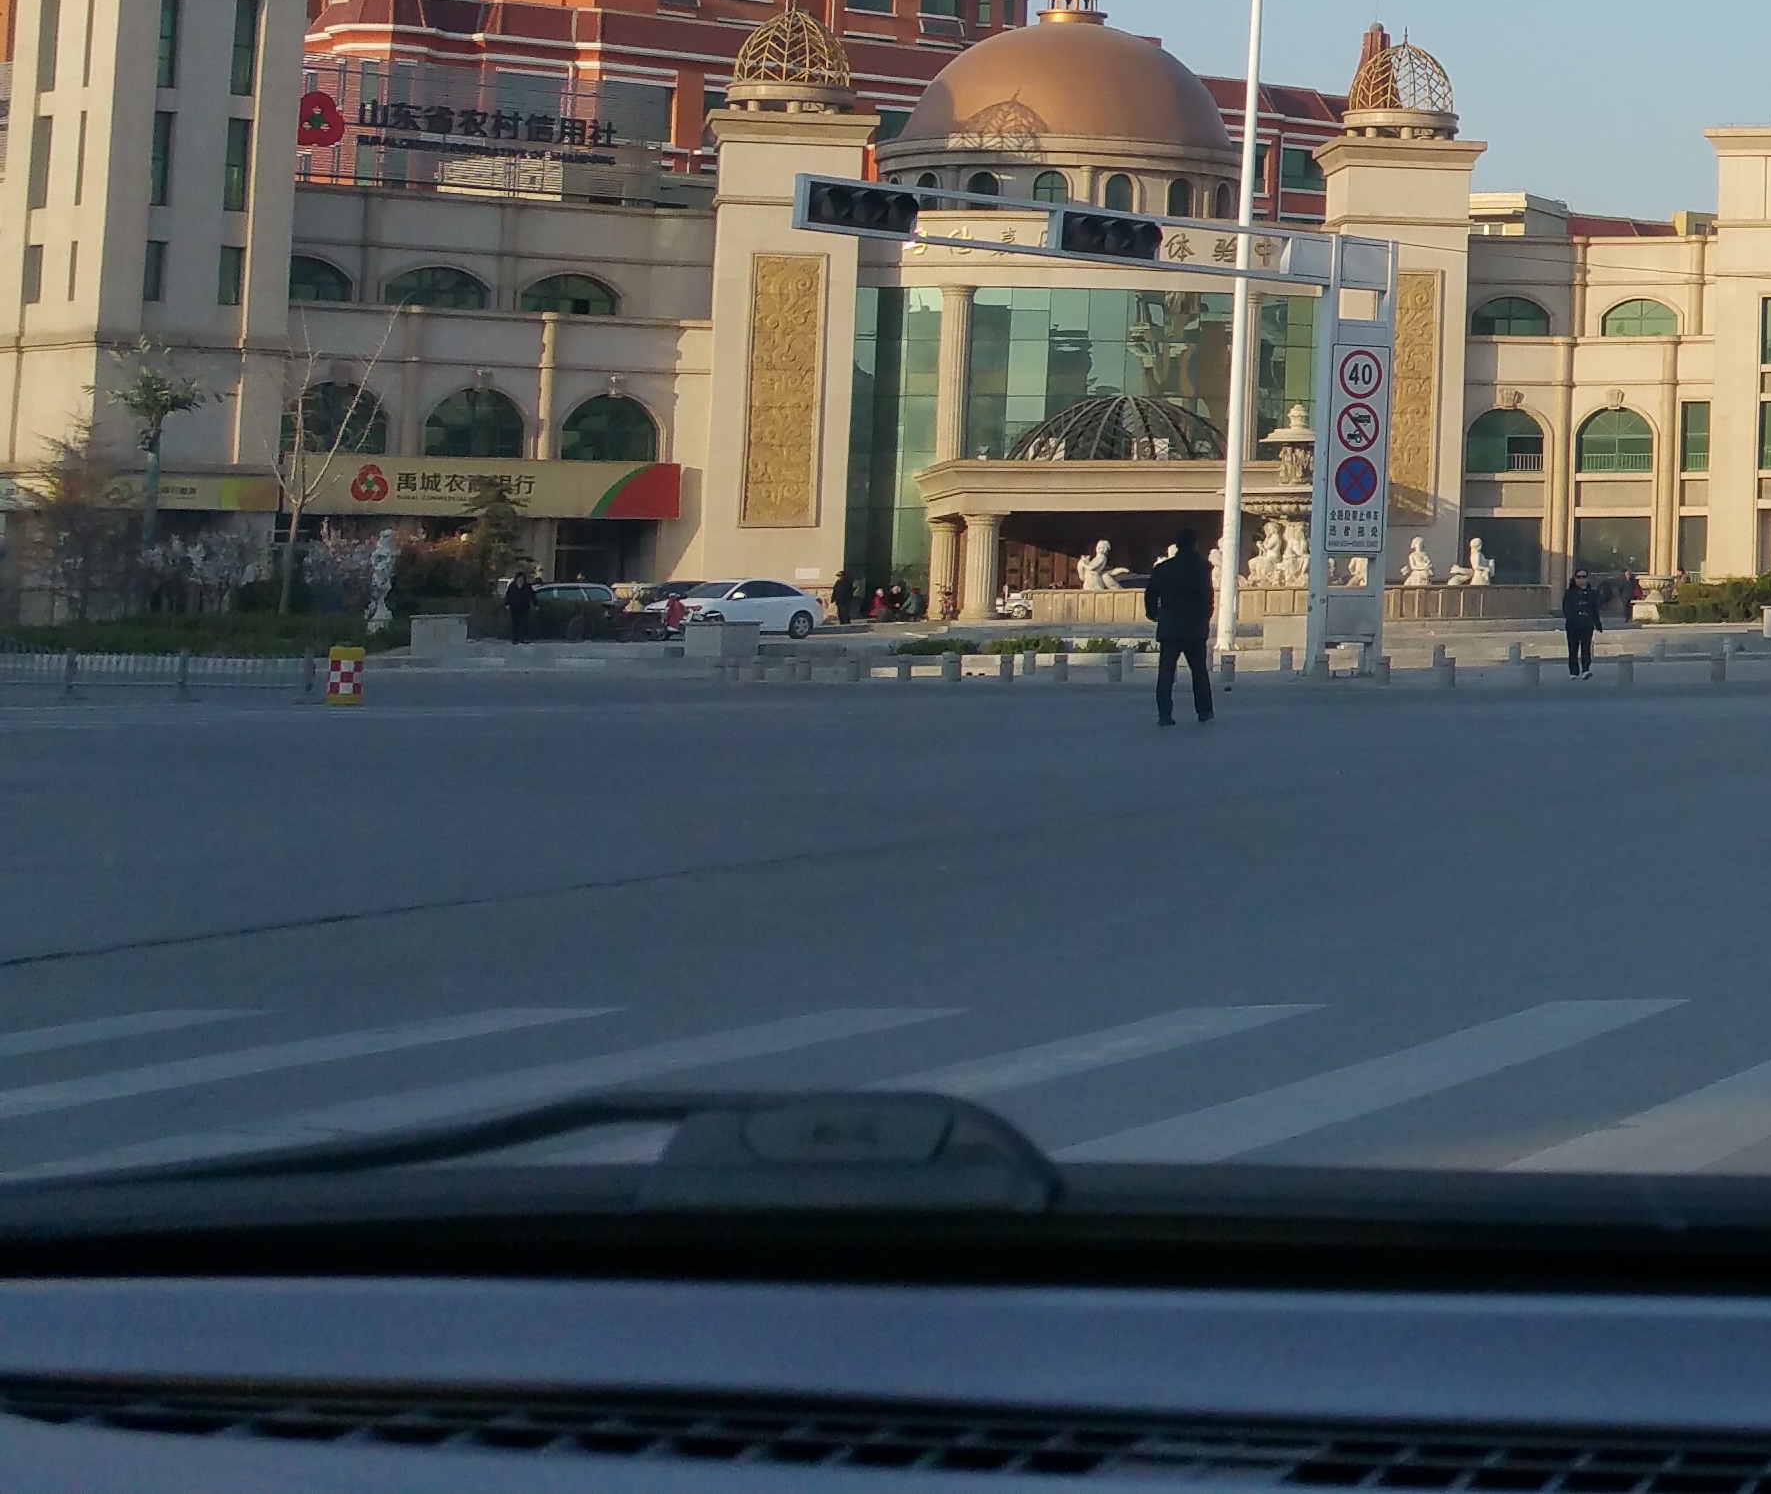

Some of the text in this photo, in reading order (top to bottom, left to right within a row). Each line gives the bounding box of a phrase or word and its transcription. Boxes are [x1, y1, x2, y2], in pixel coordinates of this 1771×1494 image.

[358, 98, 619, 148] 山东省农村信用社
[1348, 363, 1373, 386] 40
